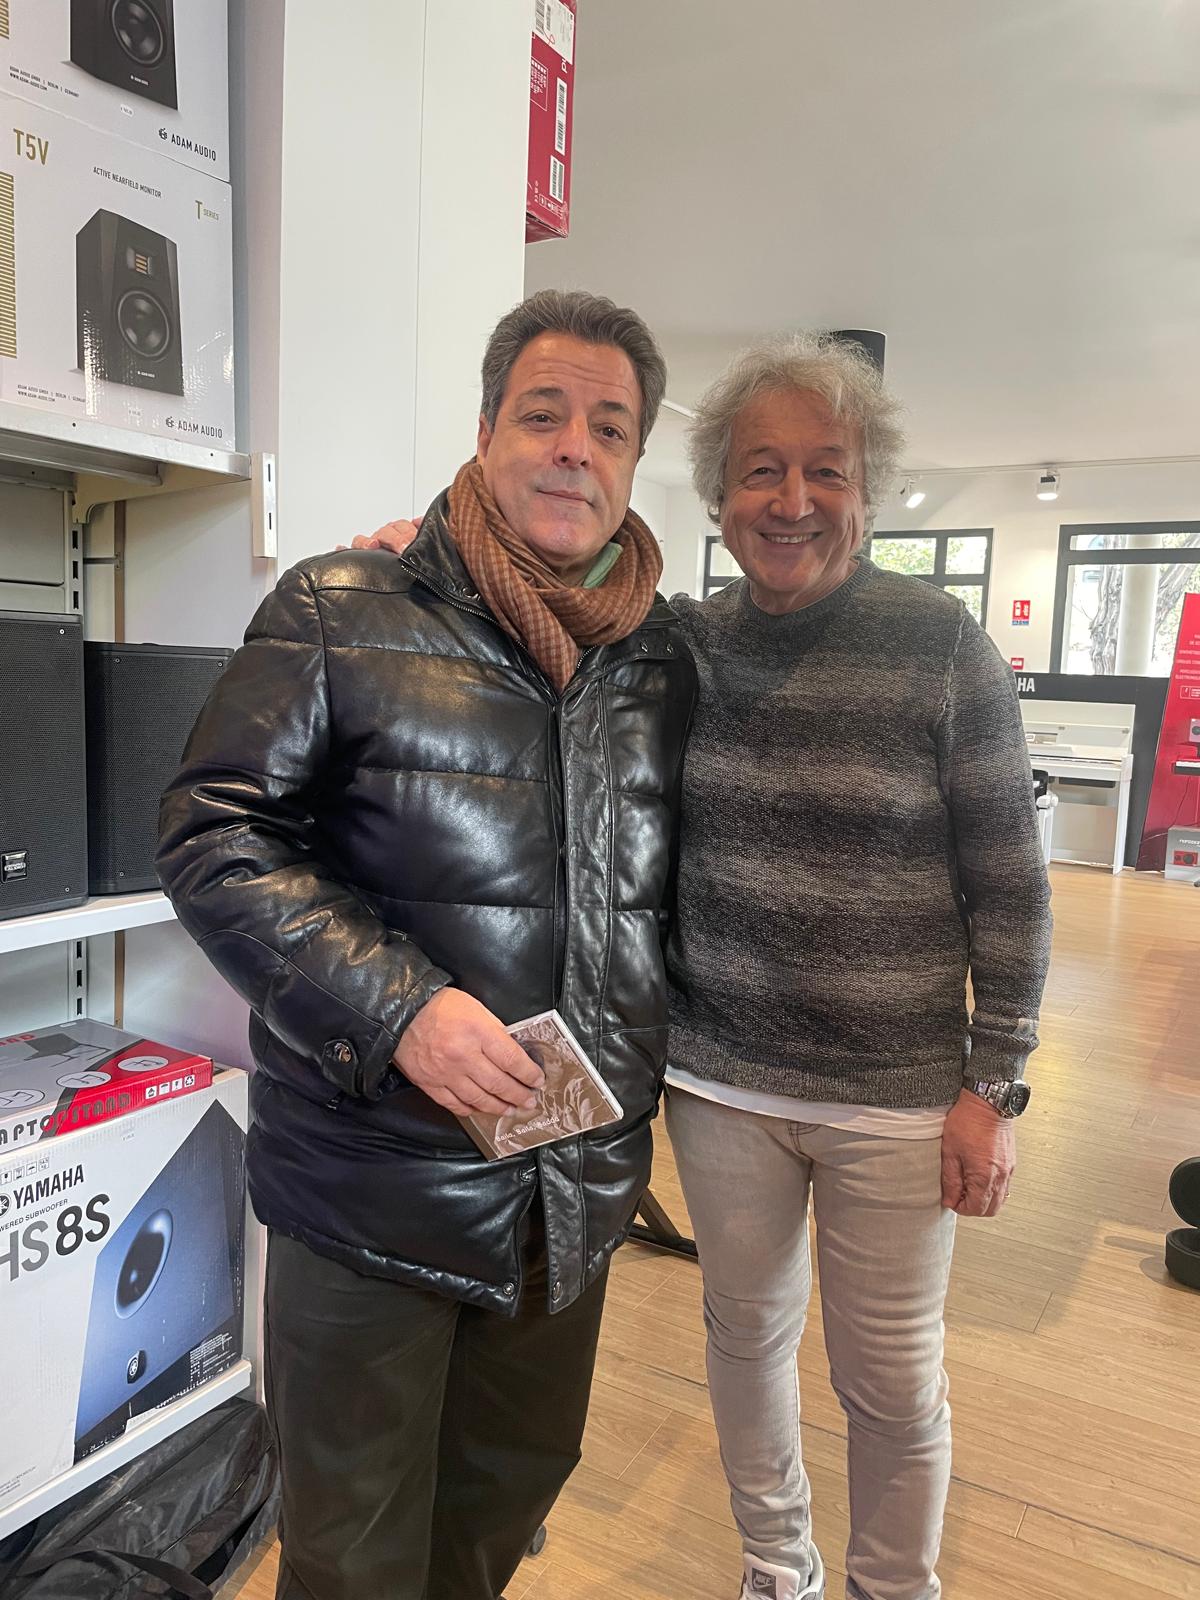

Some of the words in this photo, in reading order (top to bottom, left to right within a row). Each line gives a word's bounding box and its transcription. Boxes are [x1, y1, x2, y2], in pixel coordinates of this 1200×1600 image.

[13, 128, 49, 166] T5V
[171, 133, 193, 152] ADAM
[194, 143, 217, 162] AUDIO
[93, 166, 111, 180] ACTIVE
[112, 171, 139, 190] NEARFIELD
[139, 184, 162, 198] MONITOR
[195, 199, 203, 220] T
[203, 208, 220, 221] SERIES
[178, 420, 199, 434] ADAM
[200, 428, 223, 439] AUDIO
[1017, 677, 1036, 693] HA
[13, 1164, 84, 1209] YAMAHA
[25, 1198, 68, 1221] SUBWOOFER
